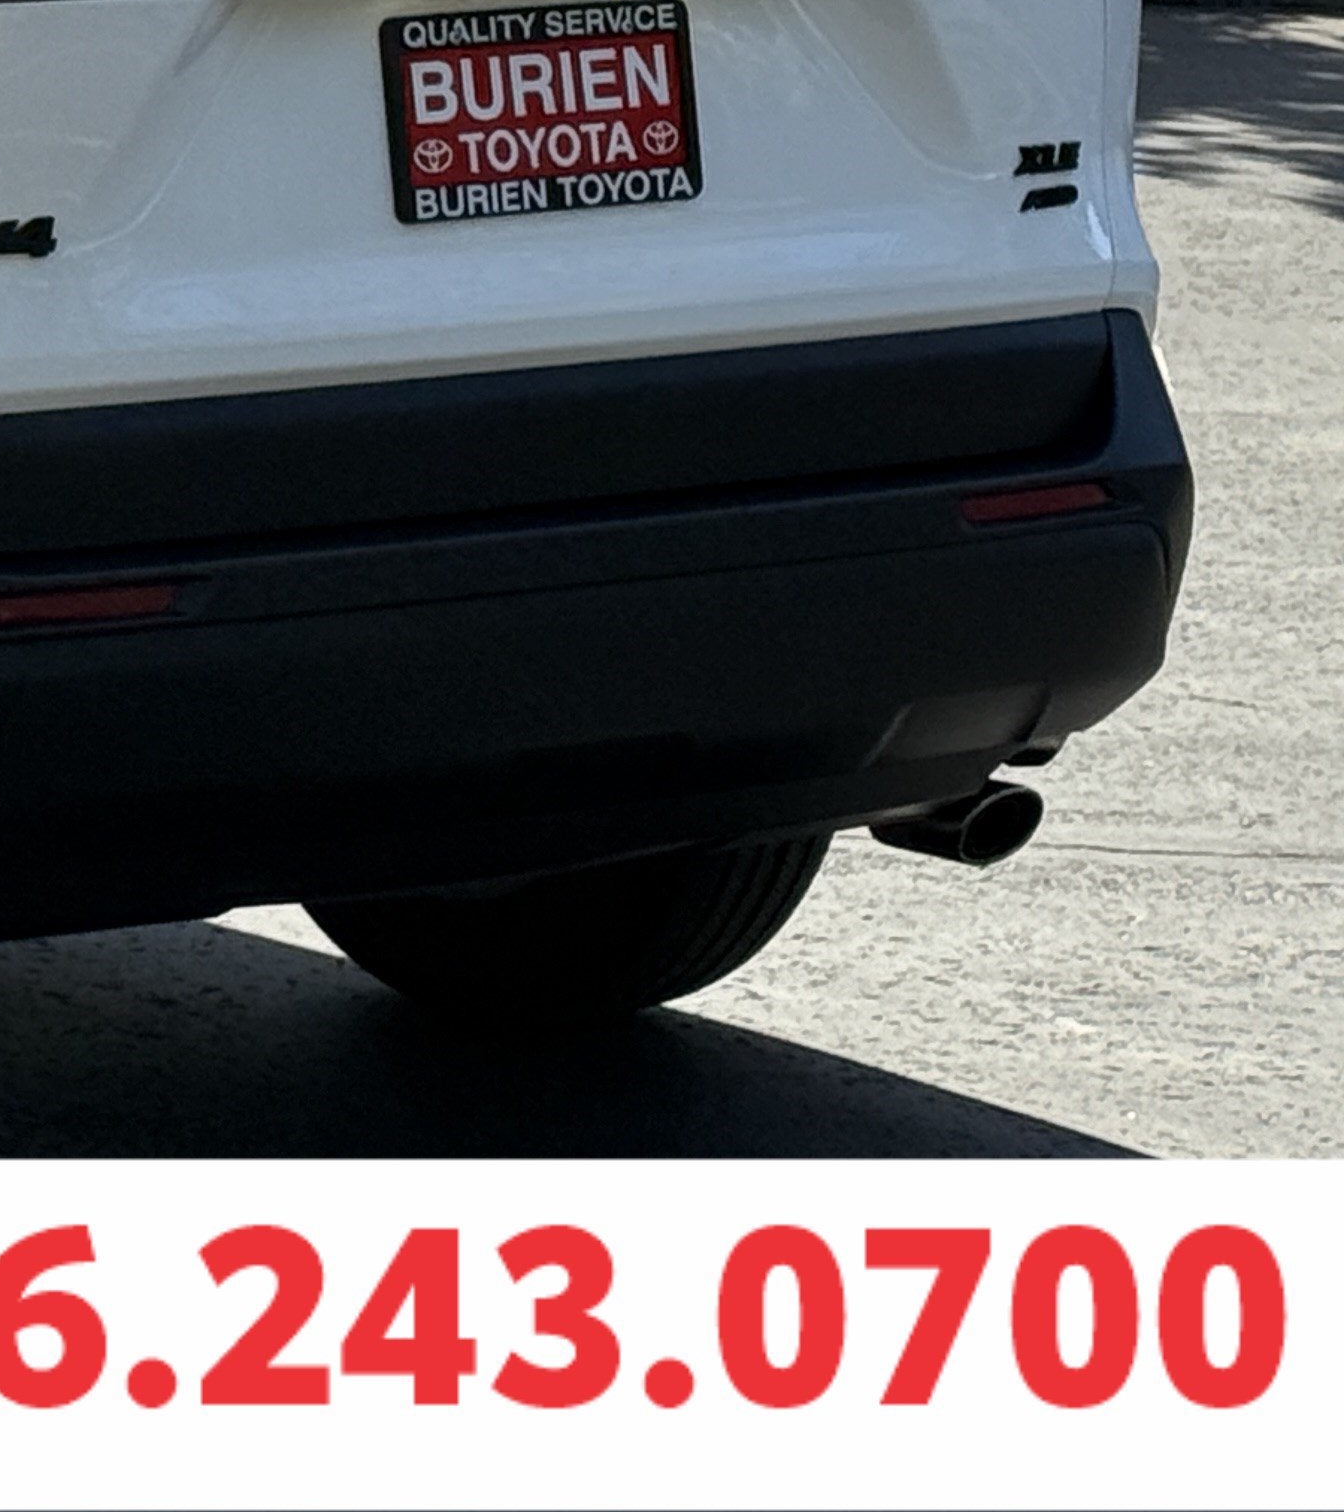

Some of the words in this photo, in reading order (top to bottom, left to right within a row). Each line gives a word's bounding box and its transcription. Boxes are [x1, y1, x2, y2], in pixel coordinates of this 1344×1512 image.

[402, 13, 536, 49] QUALITY
[544, 3, 678, 37] SERVICE
[410, 43, 672, 125] BURIEN
[458, 120, 638, 175] TOYOTA
[415, 177, 549, 221] BURIEN
[556, 166, 695, 209] TOYOTA
